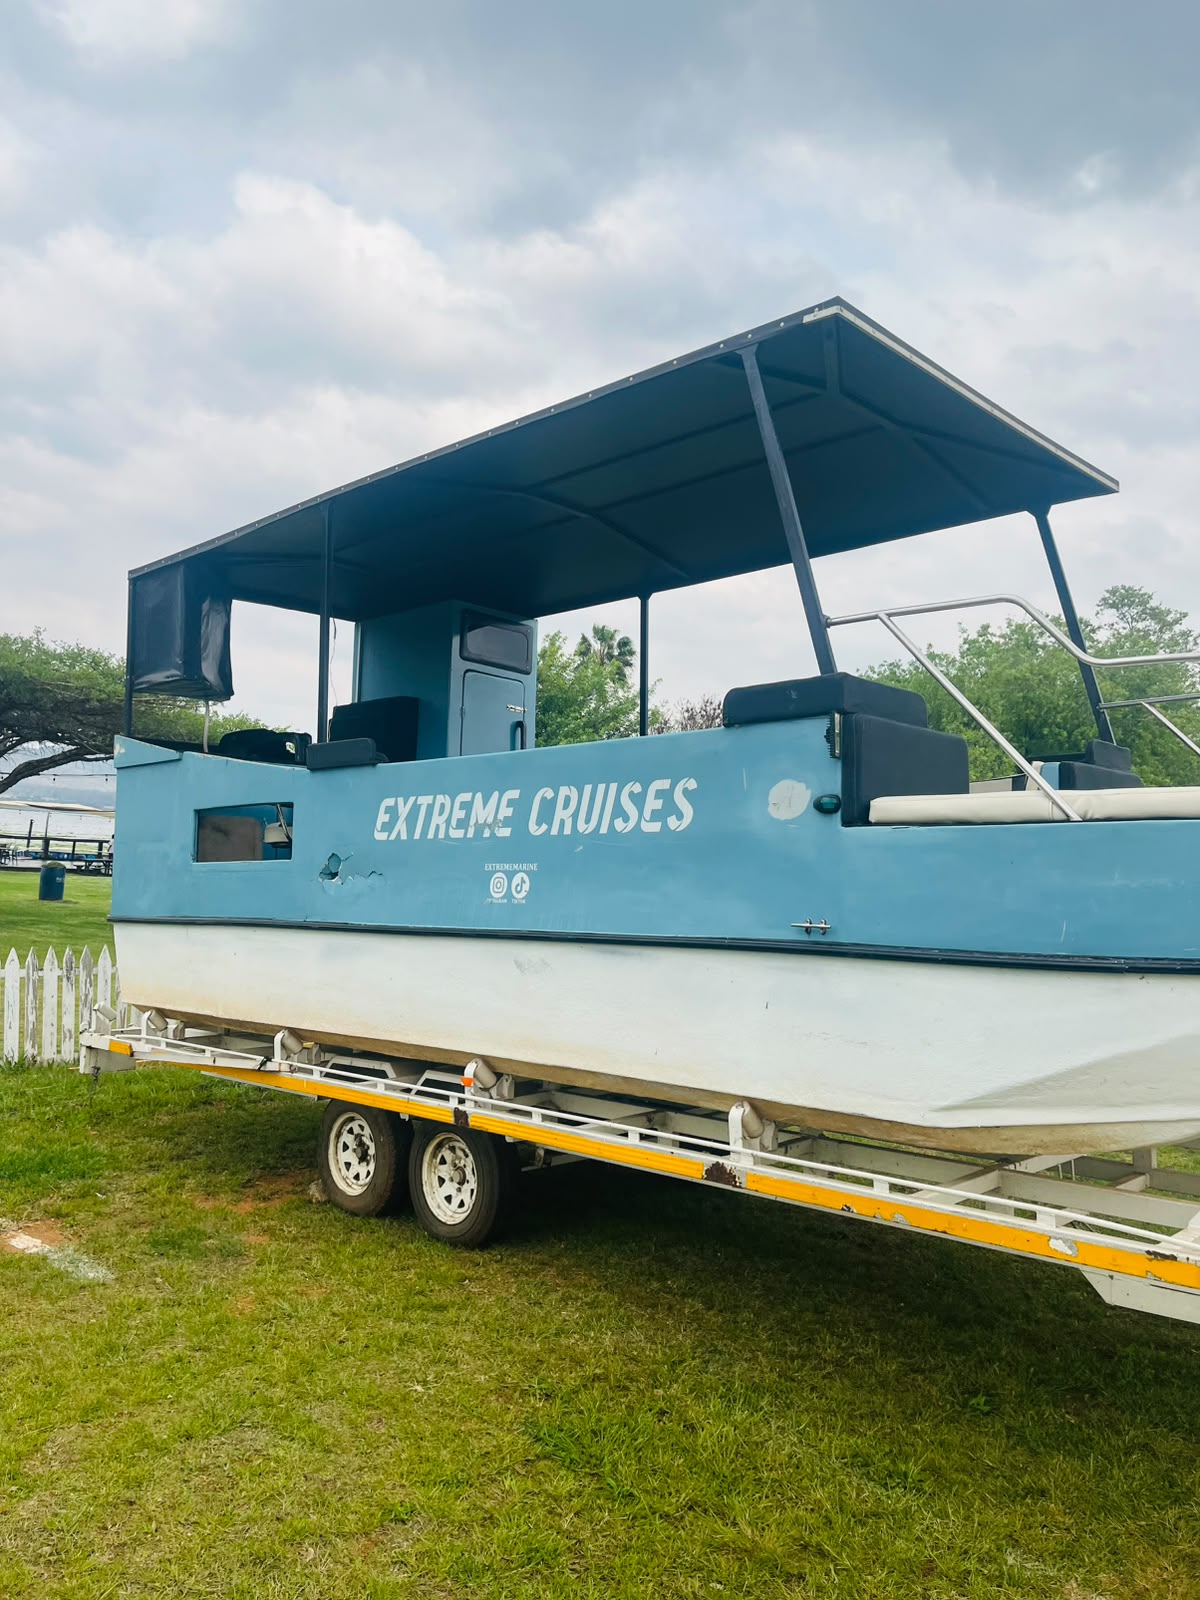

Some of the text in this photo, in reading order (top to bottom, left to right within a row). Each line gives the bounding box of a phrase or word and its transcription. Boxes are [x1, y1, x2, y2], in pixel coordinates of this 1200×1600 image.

[374, 777, 698, 840] EXTREME CRUISES
[484, 863, 538, 871] EXTREMEMARINE
